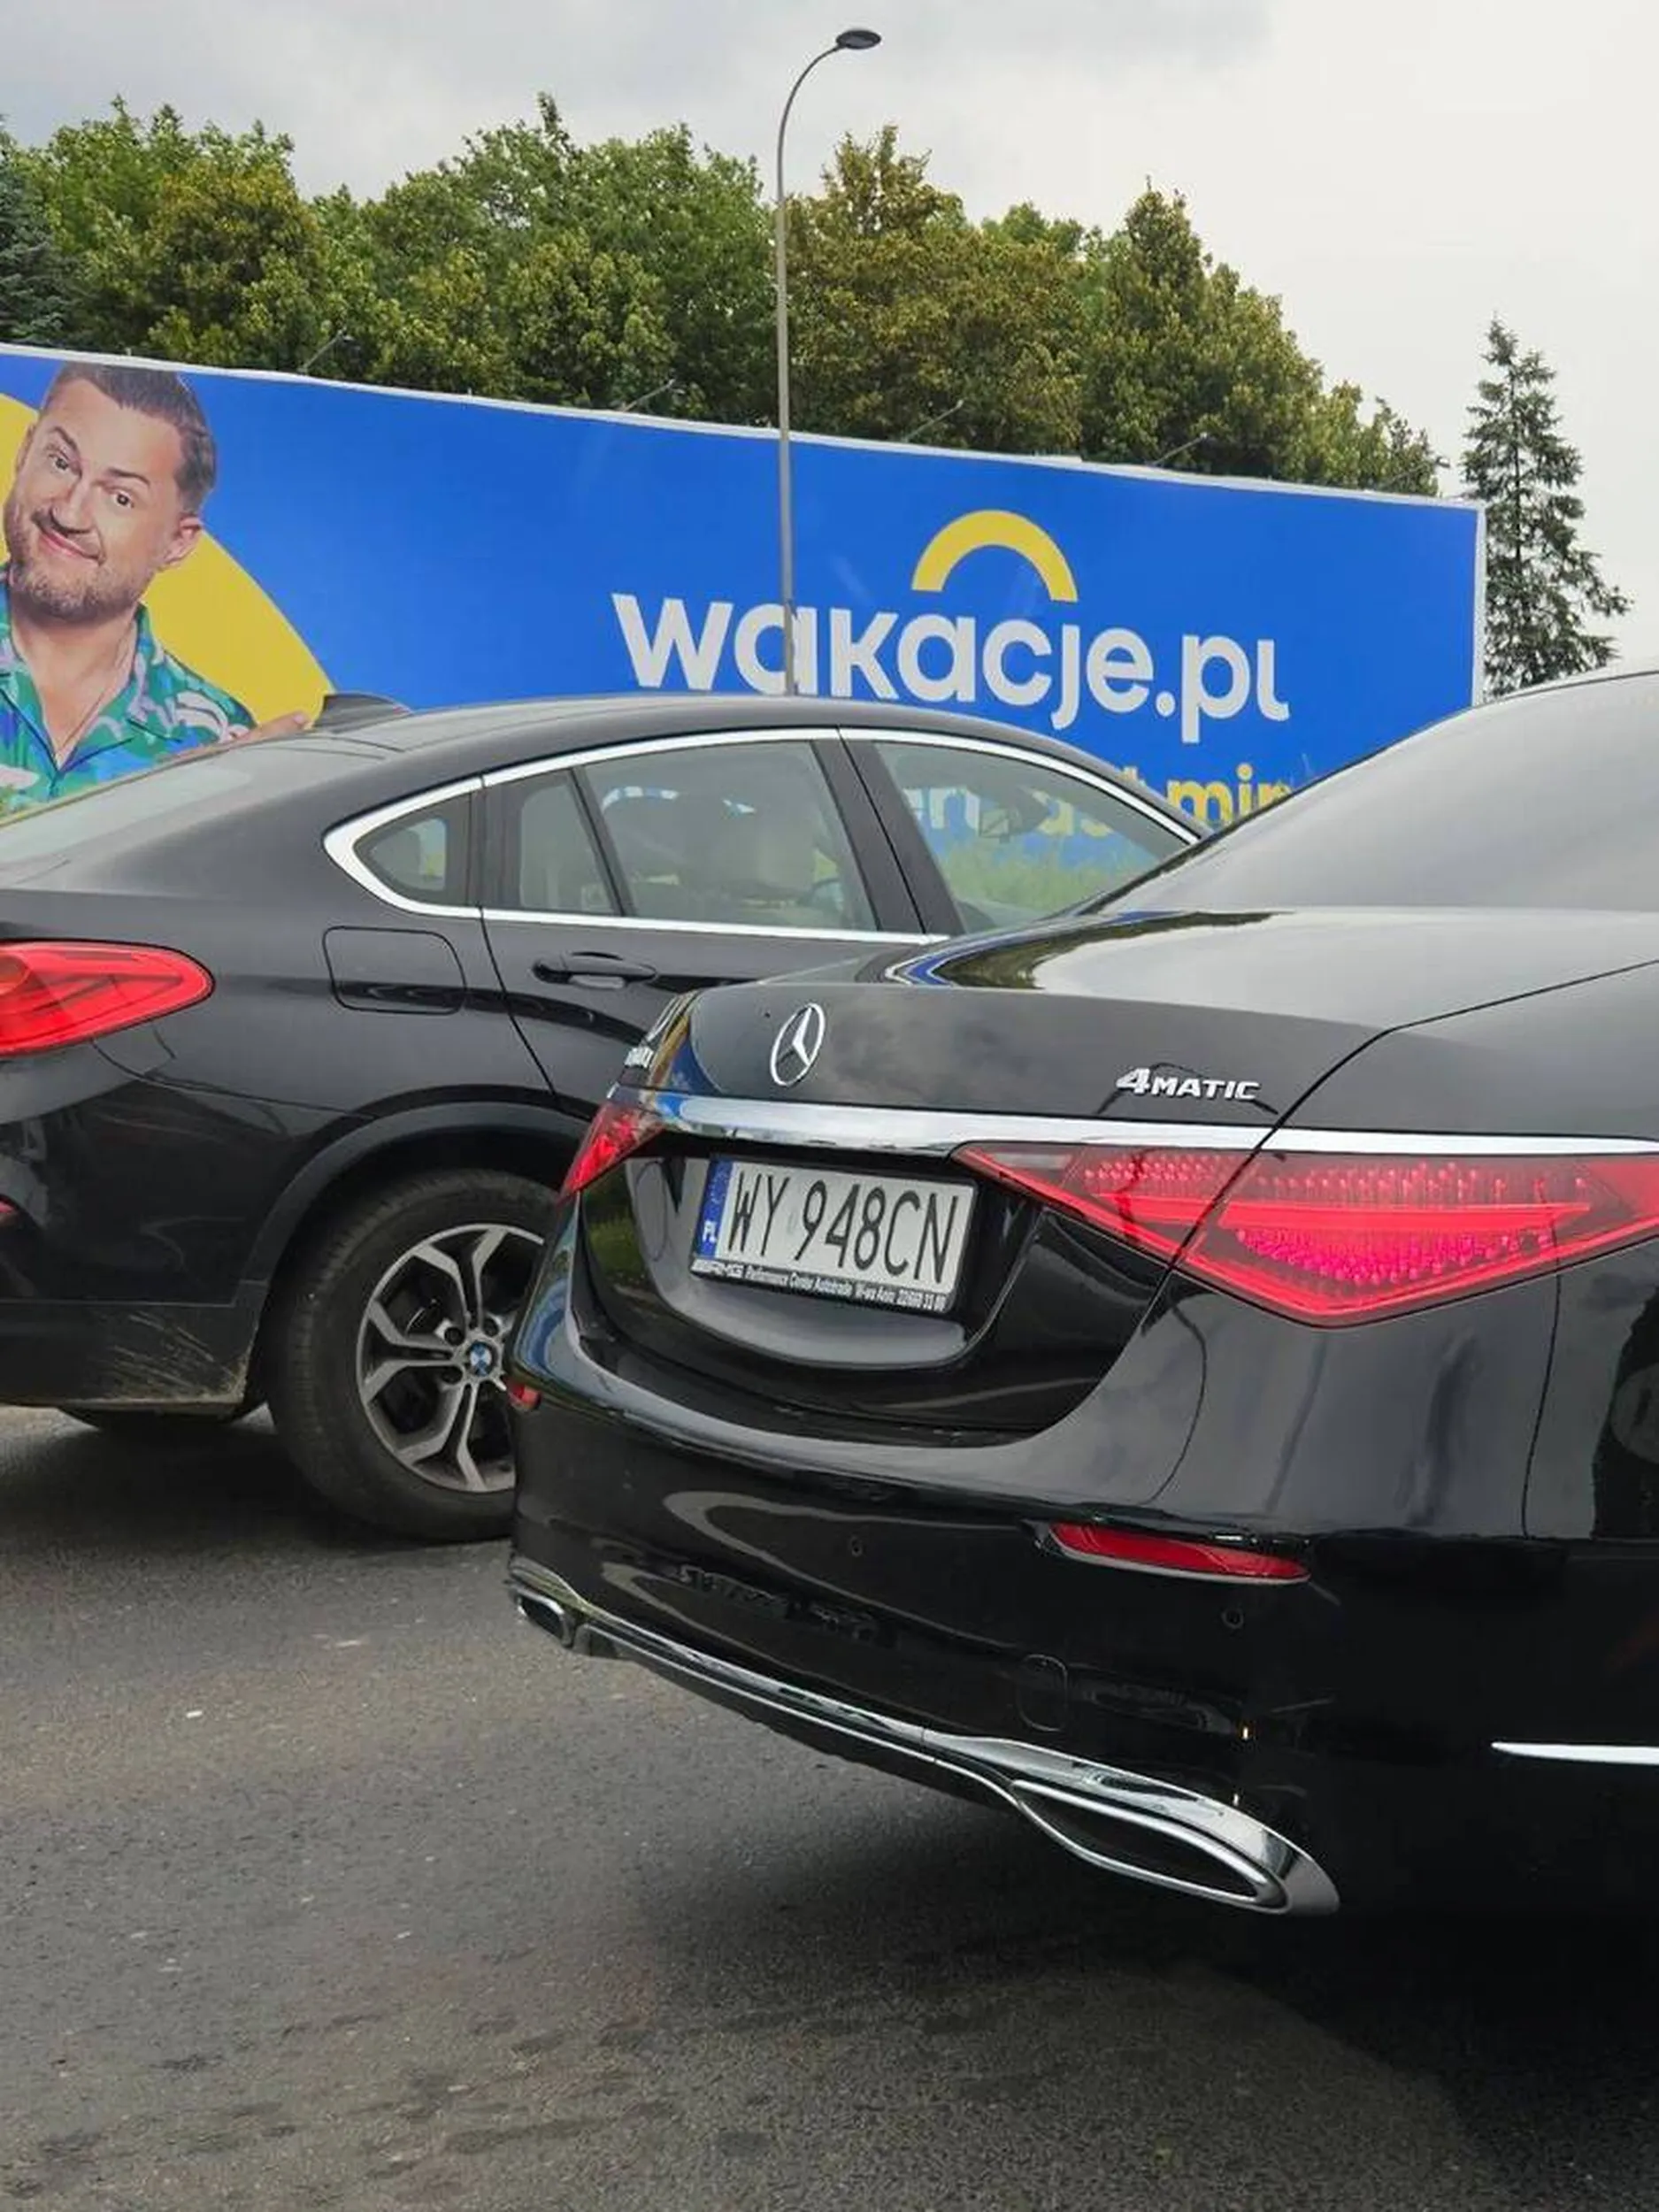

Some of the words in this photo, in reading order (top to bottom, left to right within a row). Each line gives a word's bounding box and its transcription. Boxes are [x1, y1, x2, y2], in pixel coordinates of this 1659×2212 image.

[611, 592, 1290, 744] wakacje.pl
[1116, 1067, 1261, 1101] 4MATIC
[727, 1171, 791, 1257] WY
[795, 1179, 959, 1285] 948CN
